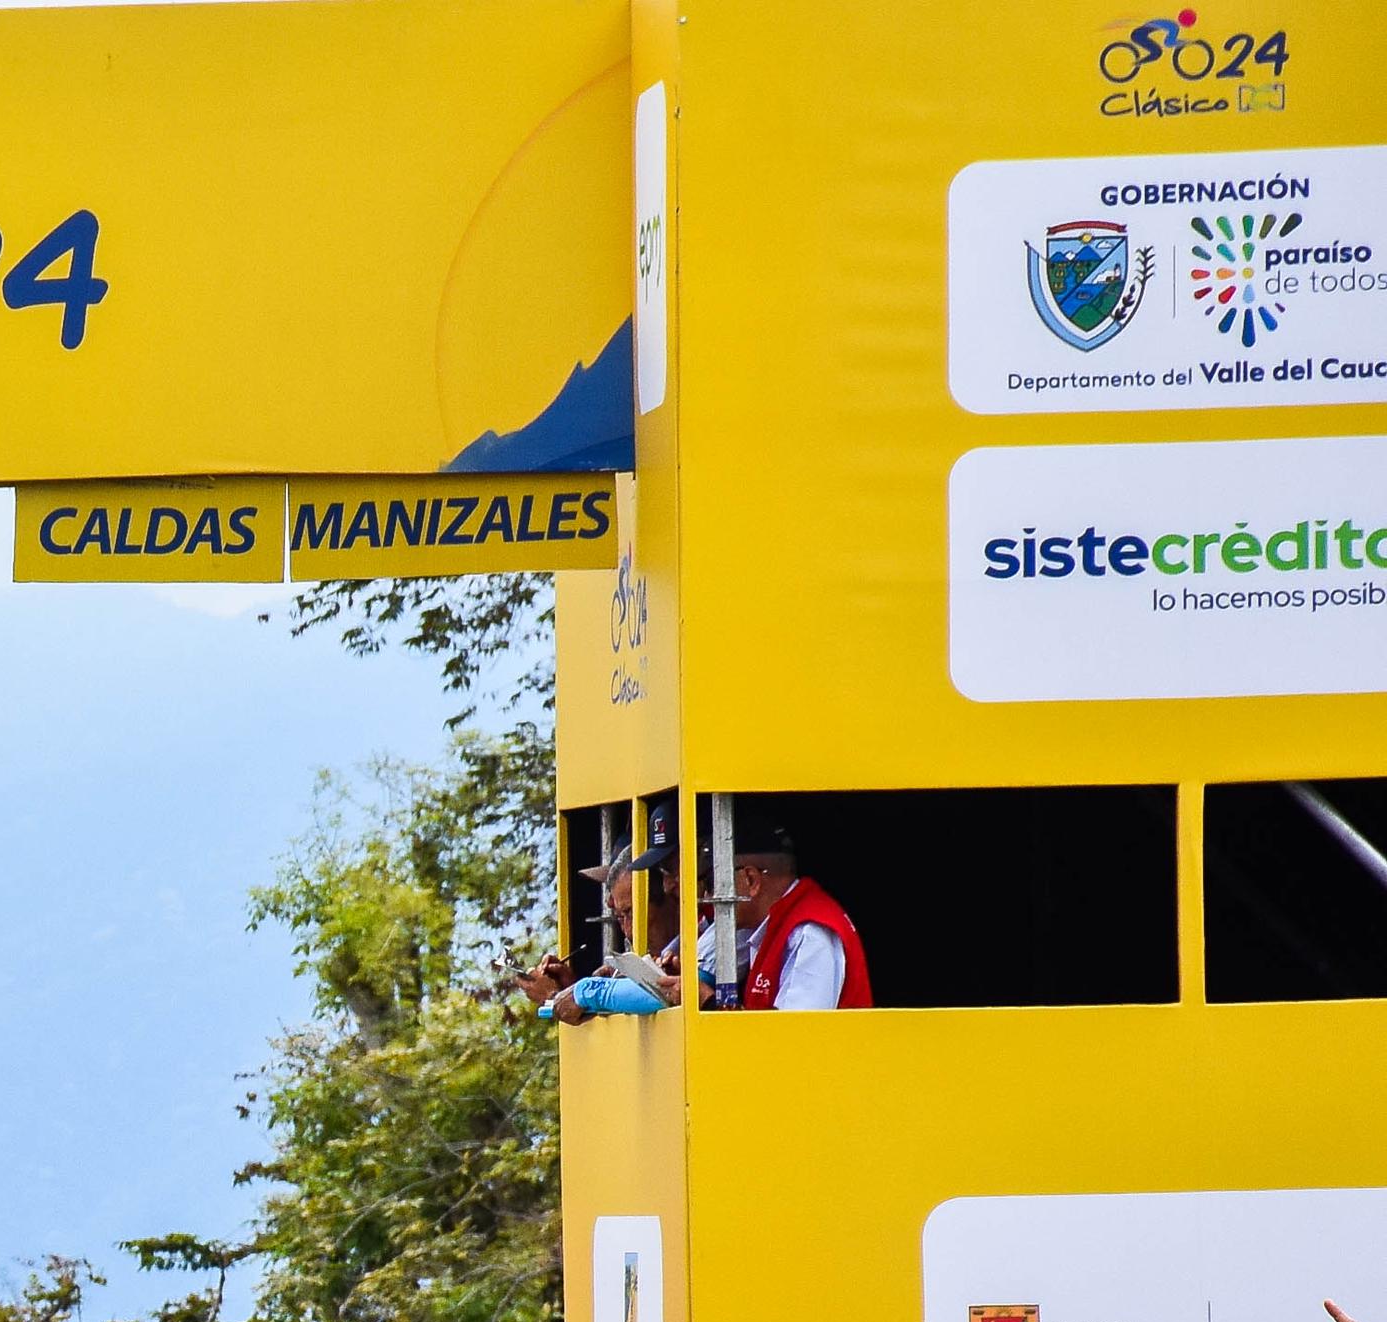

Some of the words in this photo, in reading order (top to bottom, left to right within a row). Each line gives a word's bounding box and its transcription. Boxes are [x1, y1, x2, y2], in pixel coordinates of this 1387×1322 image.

[1216, 30, 1289, 79] 24
[1100, 88, 1229, 118] Clásico
[1100, 172, 1310, 206] GOBERNACIÓN
[1265, 240, 1372, 270] paraíso
[1265, 269, 1299, 295] de
[1310, 266, 1387, 293] todos
[1008, 371, 1156, 392] Departamento
[1162, 368, 1192, 387] del
[1199, 361, 1265, 385] Valle
[1272, 357, 1313, 381] del
[1320, 357, 1387, 380] Cauc
[38, 506, 258, 555] CALDAS
[291, 491, 611, 551] MANIZALES
[1152, 589, 1176, 612] lo
[1182, 588, 1306, 612] hacemos
[1311, 582, 1387, 613] posib
